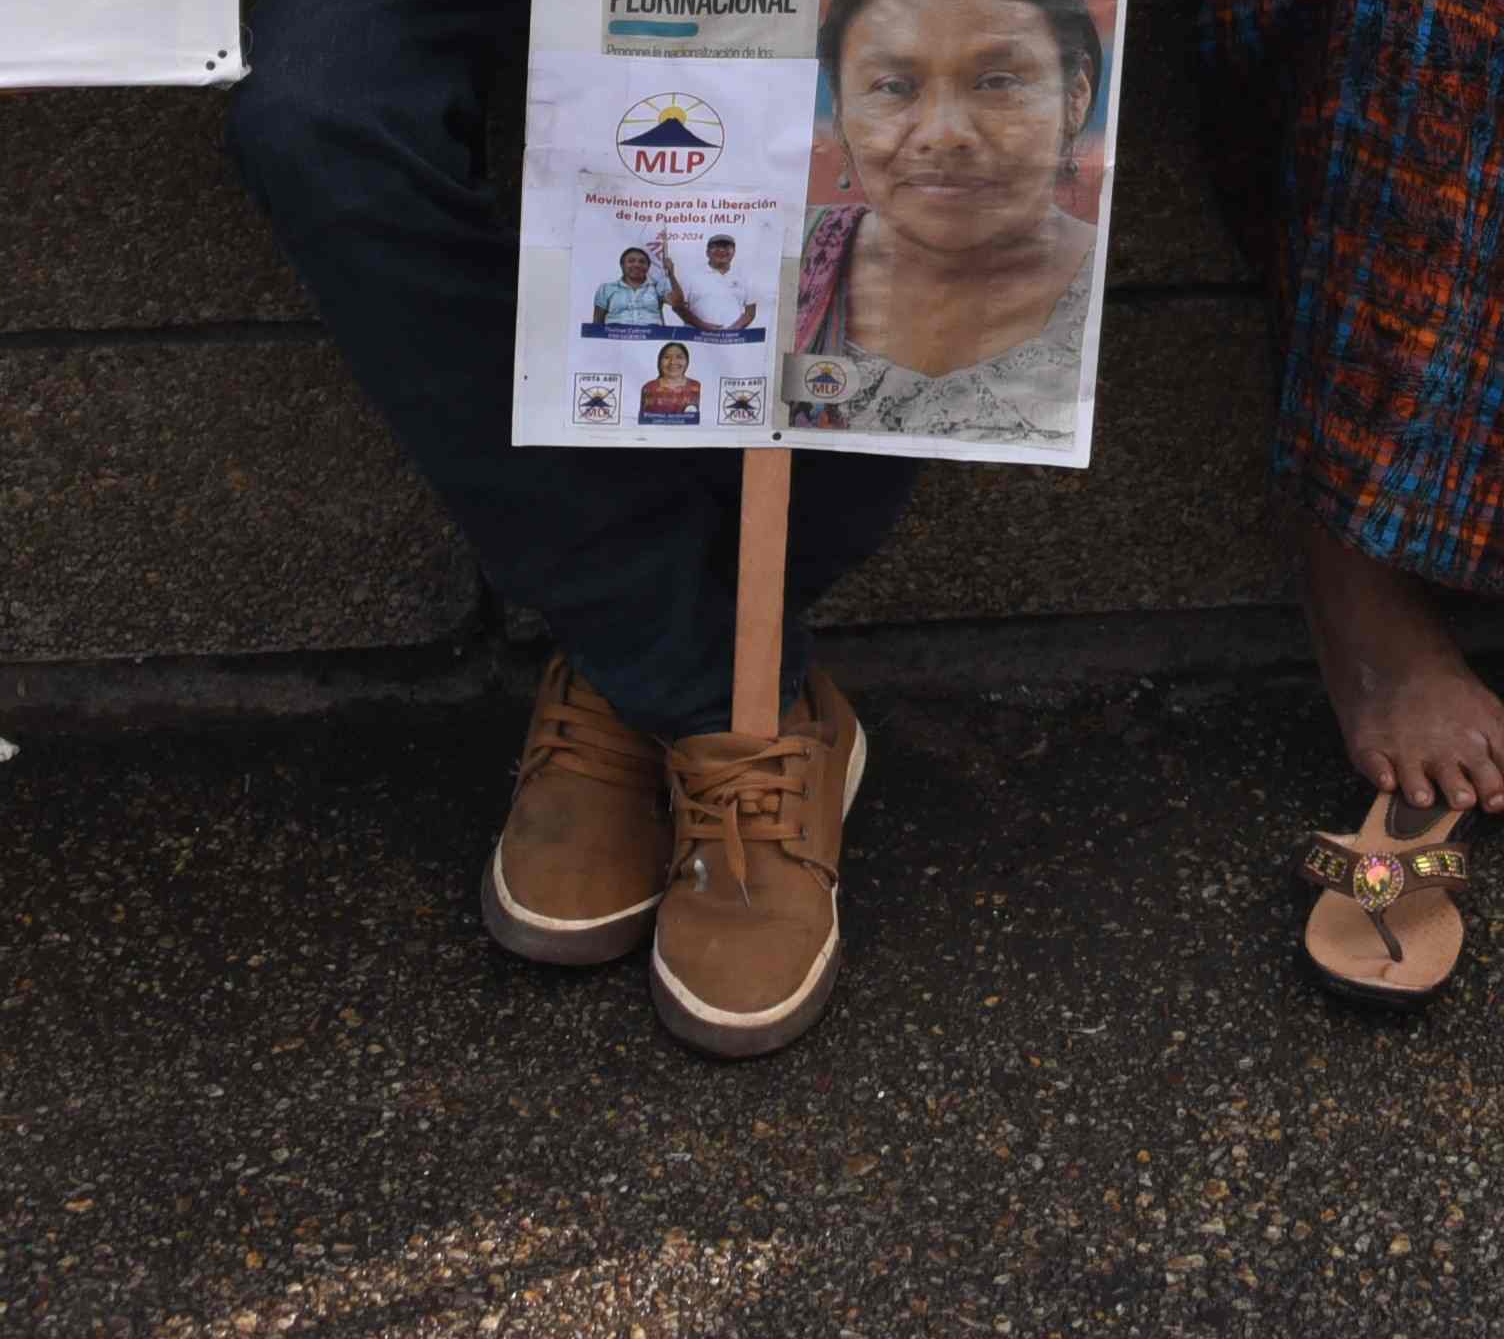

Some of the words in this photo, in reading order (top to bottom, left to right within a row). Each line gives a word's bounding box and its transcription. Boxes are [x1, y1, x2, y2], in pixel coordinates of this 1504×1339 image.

[634, 150, 705, 174] MLP
[584, 193, 662, 210] Movimiento
[665, 200, 694, 211] para
[696, 198, 708, 210] la
[711, 199, 777, 211] Liberación
[615, 209, 632, 221] de
[634, 212, 653, 223] los
[655, 212, 707, 224] Pueblos
[709, 213, 746, 225] (MLP)
